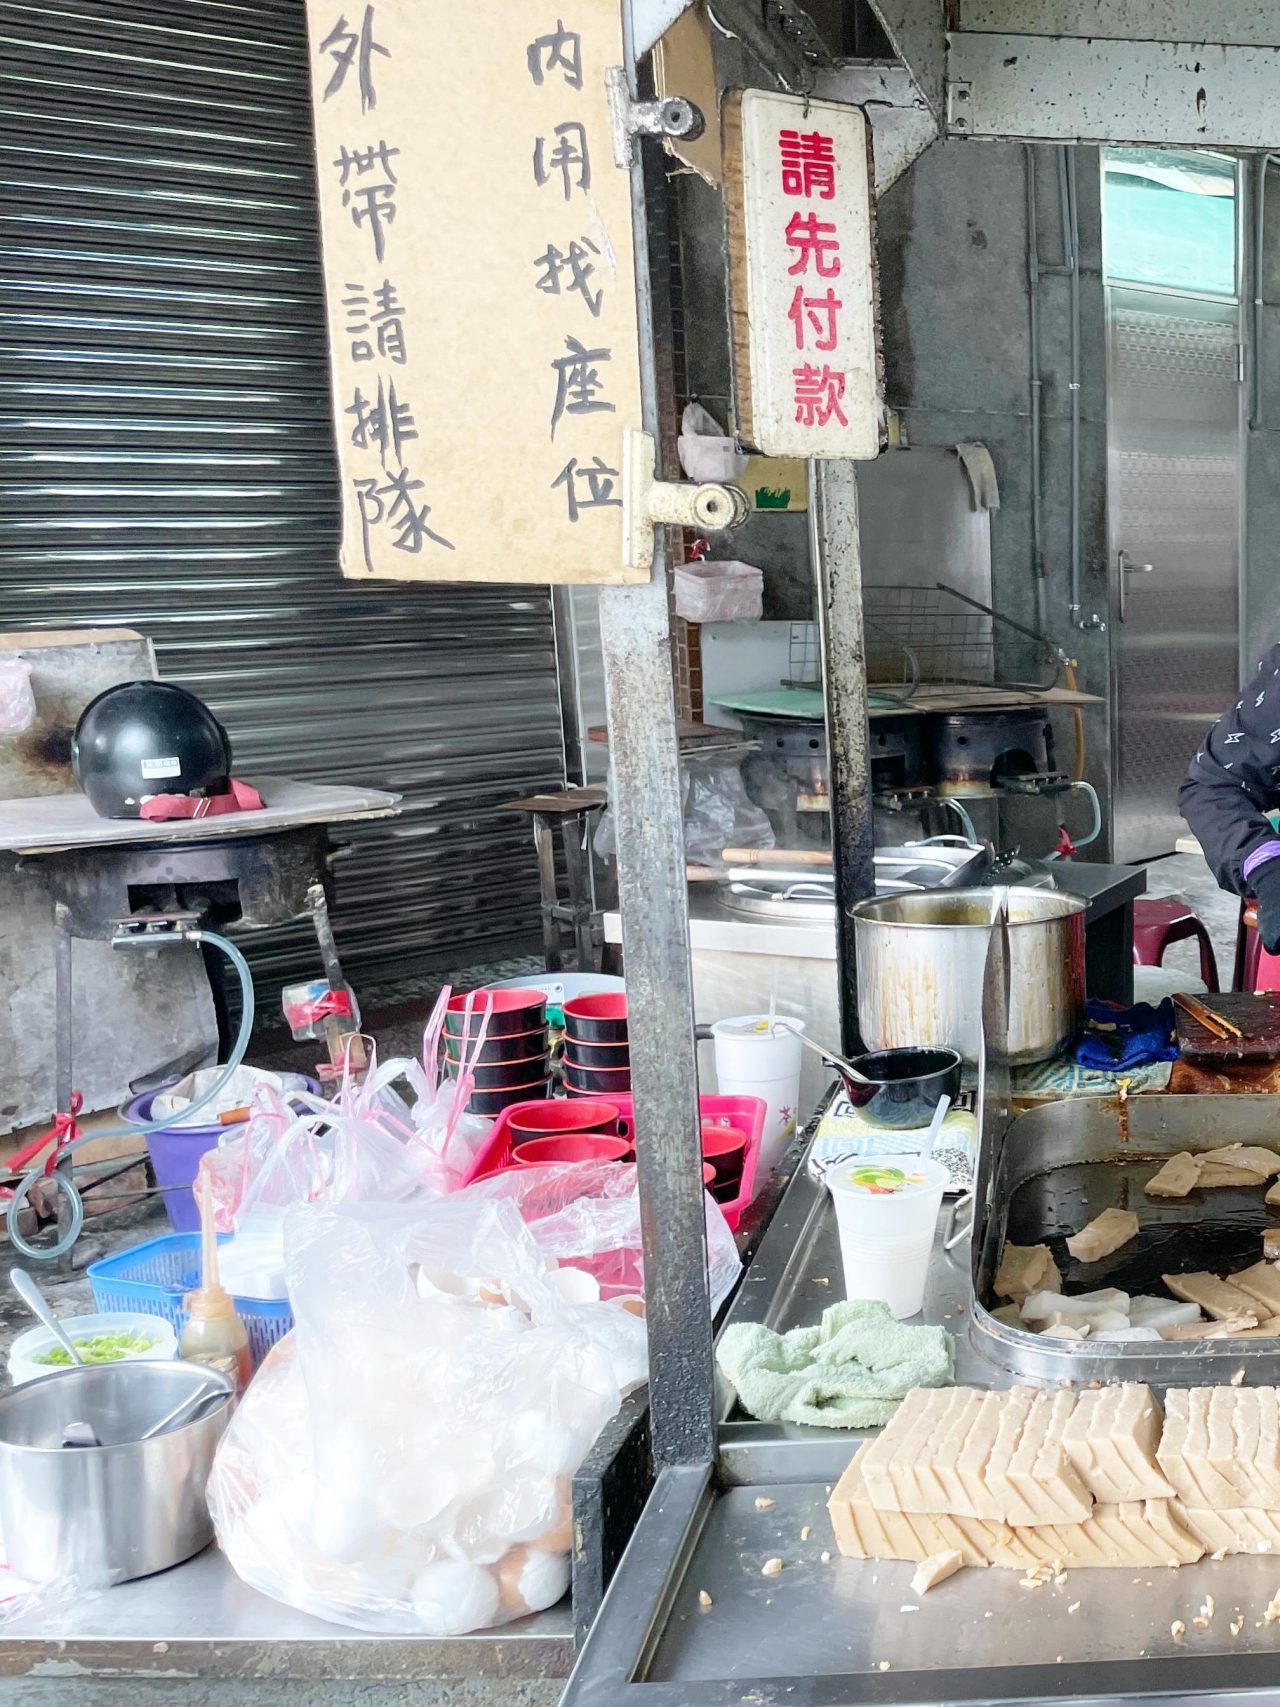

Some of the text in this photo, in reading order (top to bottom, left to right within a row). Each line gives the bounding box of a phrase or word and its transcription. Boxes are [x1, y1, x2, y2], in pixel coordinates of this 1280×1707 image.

[319, 4, 455, 572] 外帶請排隊
[778, 129, 849, 428] 請先付款
